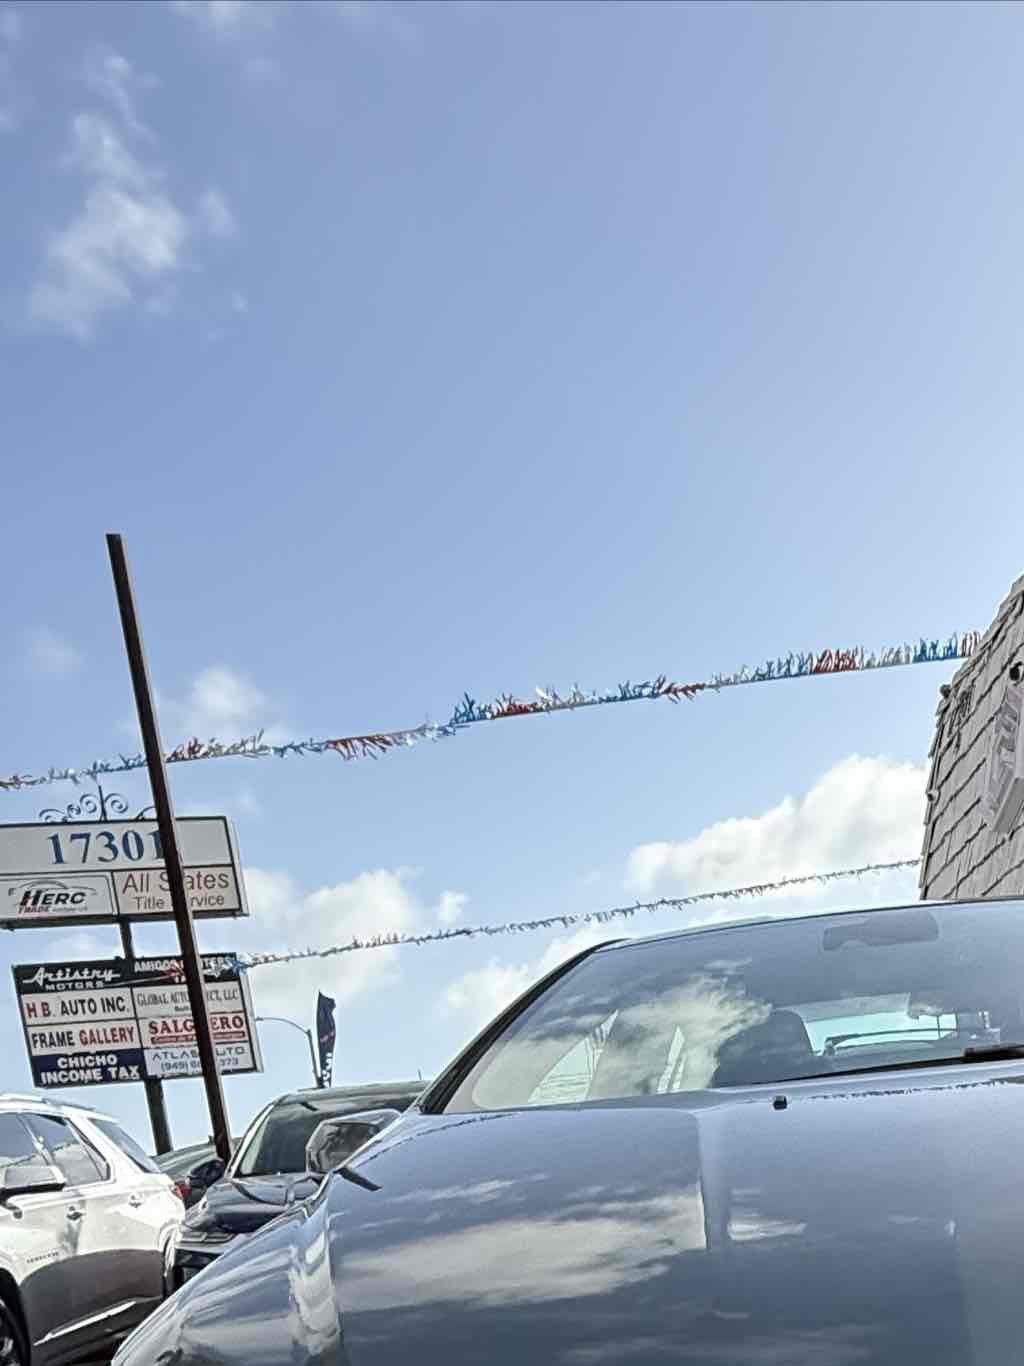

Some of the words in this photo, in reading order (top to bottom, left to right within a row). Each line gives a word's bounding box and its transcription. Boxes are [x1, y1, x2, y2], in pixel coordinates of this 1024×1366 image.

[122, 872, 150, 894] All
[159, 870, 229, 892] Sates
[132, 895, 165, 911] Title
[22, 967, 120, 986] Artistry
[45, 980, 104, 991] MOTORS
[60, 997, 98, 1016] AUTO
[100, 996, 130, 1013] INC.
[148, 1015, 244, 1034] SALGERO
[31, 1031, 76, 1048] FRAME
[79, 1026, 134, 1046] GALLERY
[56, 1054, 118, 1069] CHICHO
[40, 1067, 103, 1085] INCOME
[107, 1064, 140, 1080] TAX
